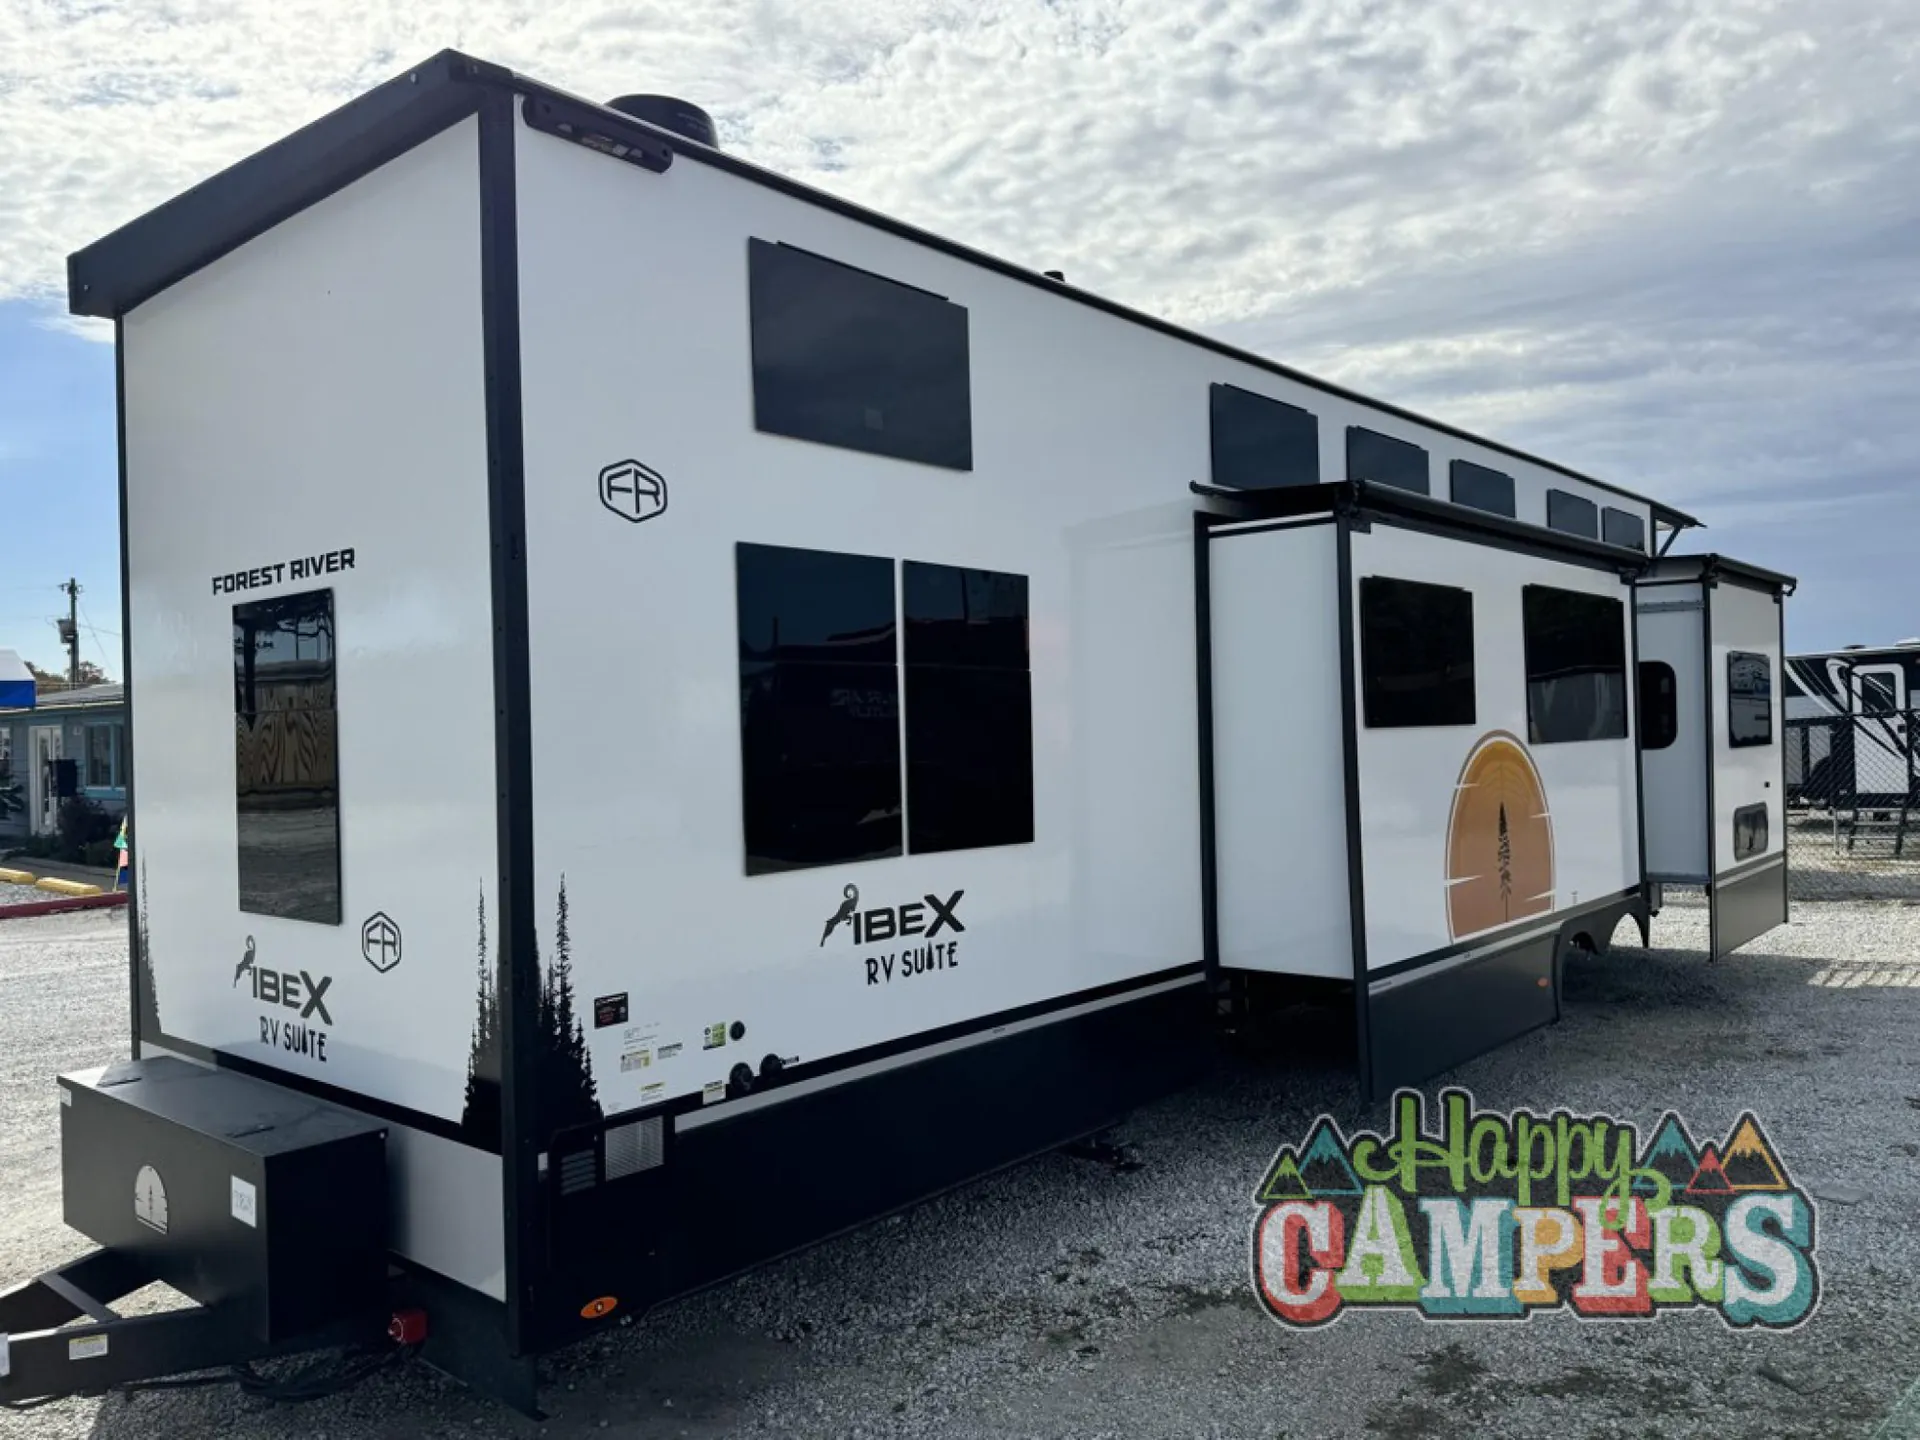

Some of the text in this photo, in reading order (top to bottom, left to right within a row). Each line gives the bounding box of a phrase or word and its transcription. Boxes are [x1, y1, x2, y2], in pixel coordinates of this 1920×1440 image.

[211, 547, 356, 596] FOREST RIVER
[853, 889, 965, 946] IBEX
[865, 941, 959, 986] RV SUITE
[251, 965, 333, 1026] IBEX
[259, 1015, 328, 1063] RV SUITE
